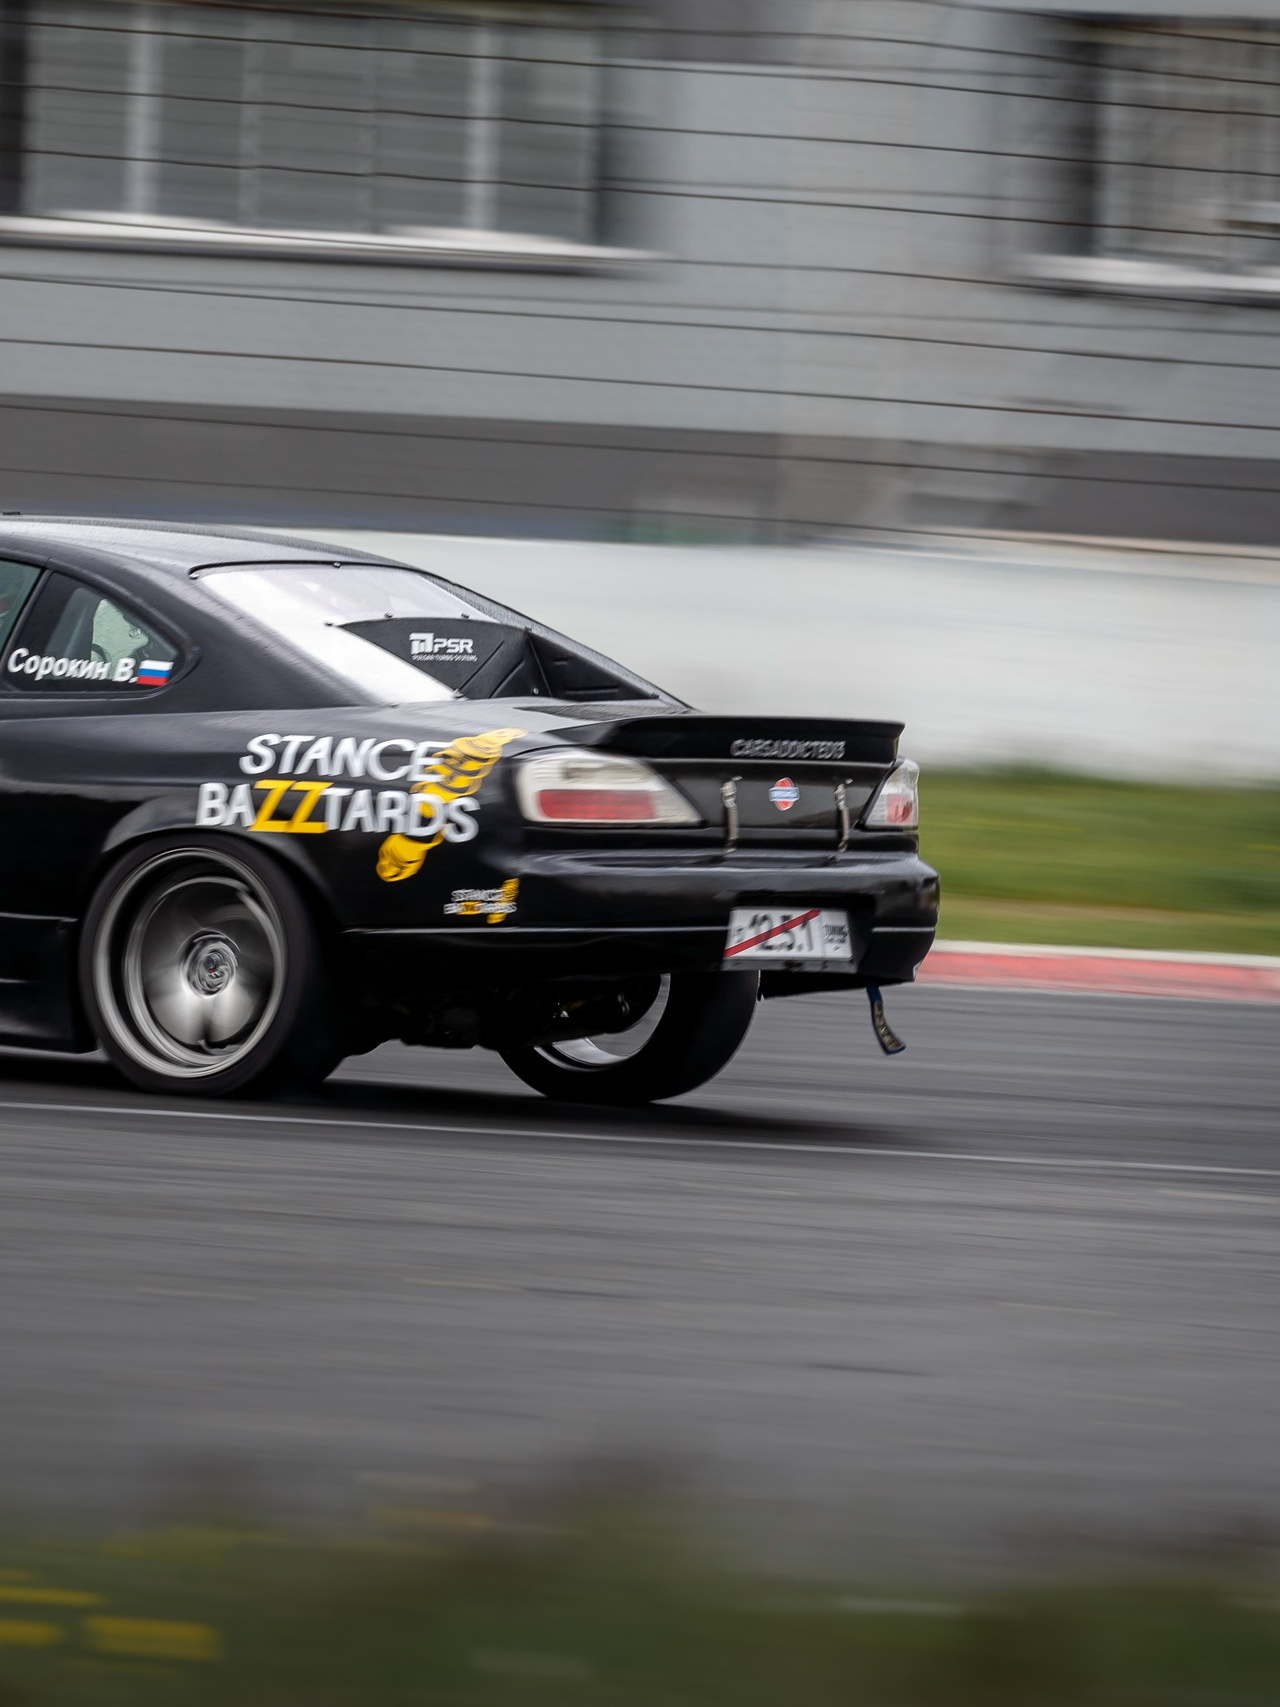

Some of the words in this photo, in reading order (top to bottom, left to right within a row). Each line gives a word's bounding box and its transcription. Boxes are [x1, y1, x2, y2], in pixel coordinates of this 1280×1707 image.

[7, 647, 111, 681] Сорокин
[433, 637, 473, 653] PSR
[239, 733, 451, 782] STANCE
[195, 779, 481, 843] BAZZTARDS
